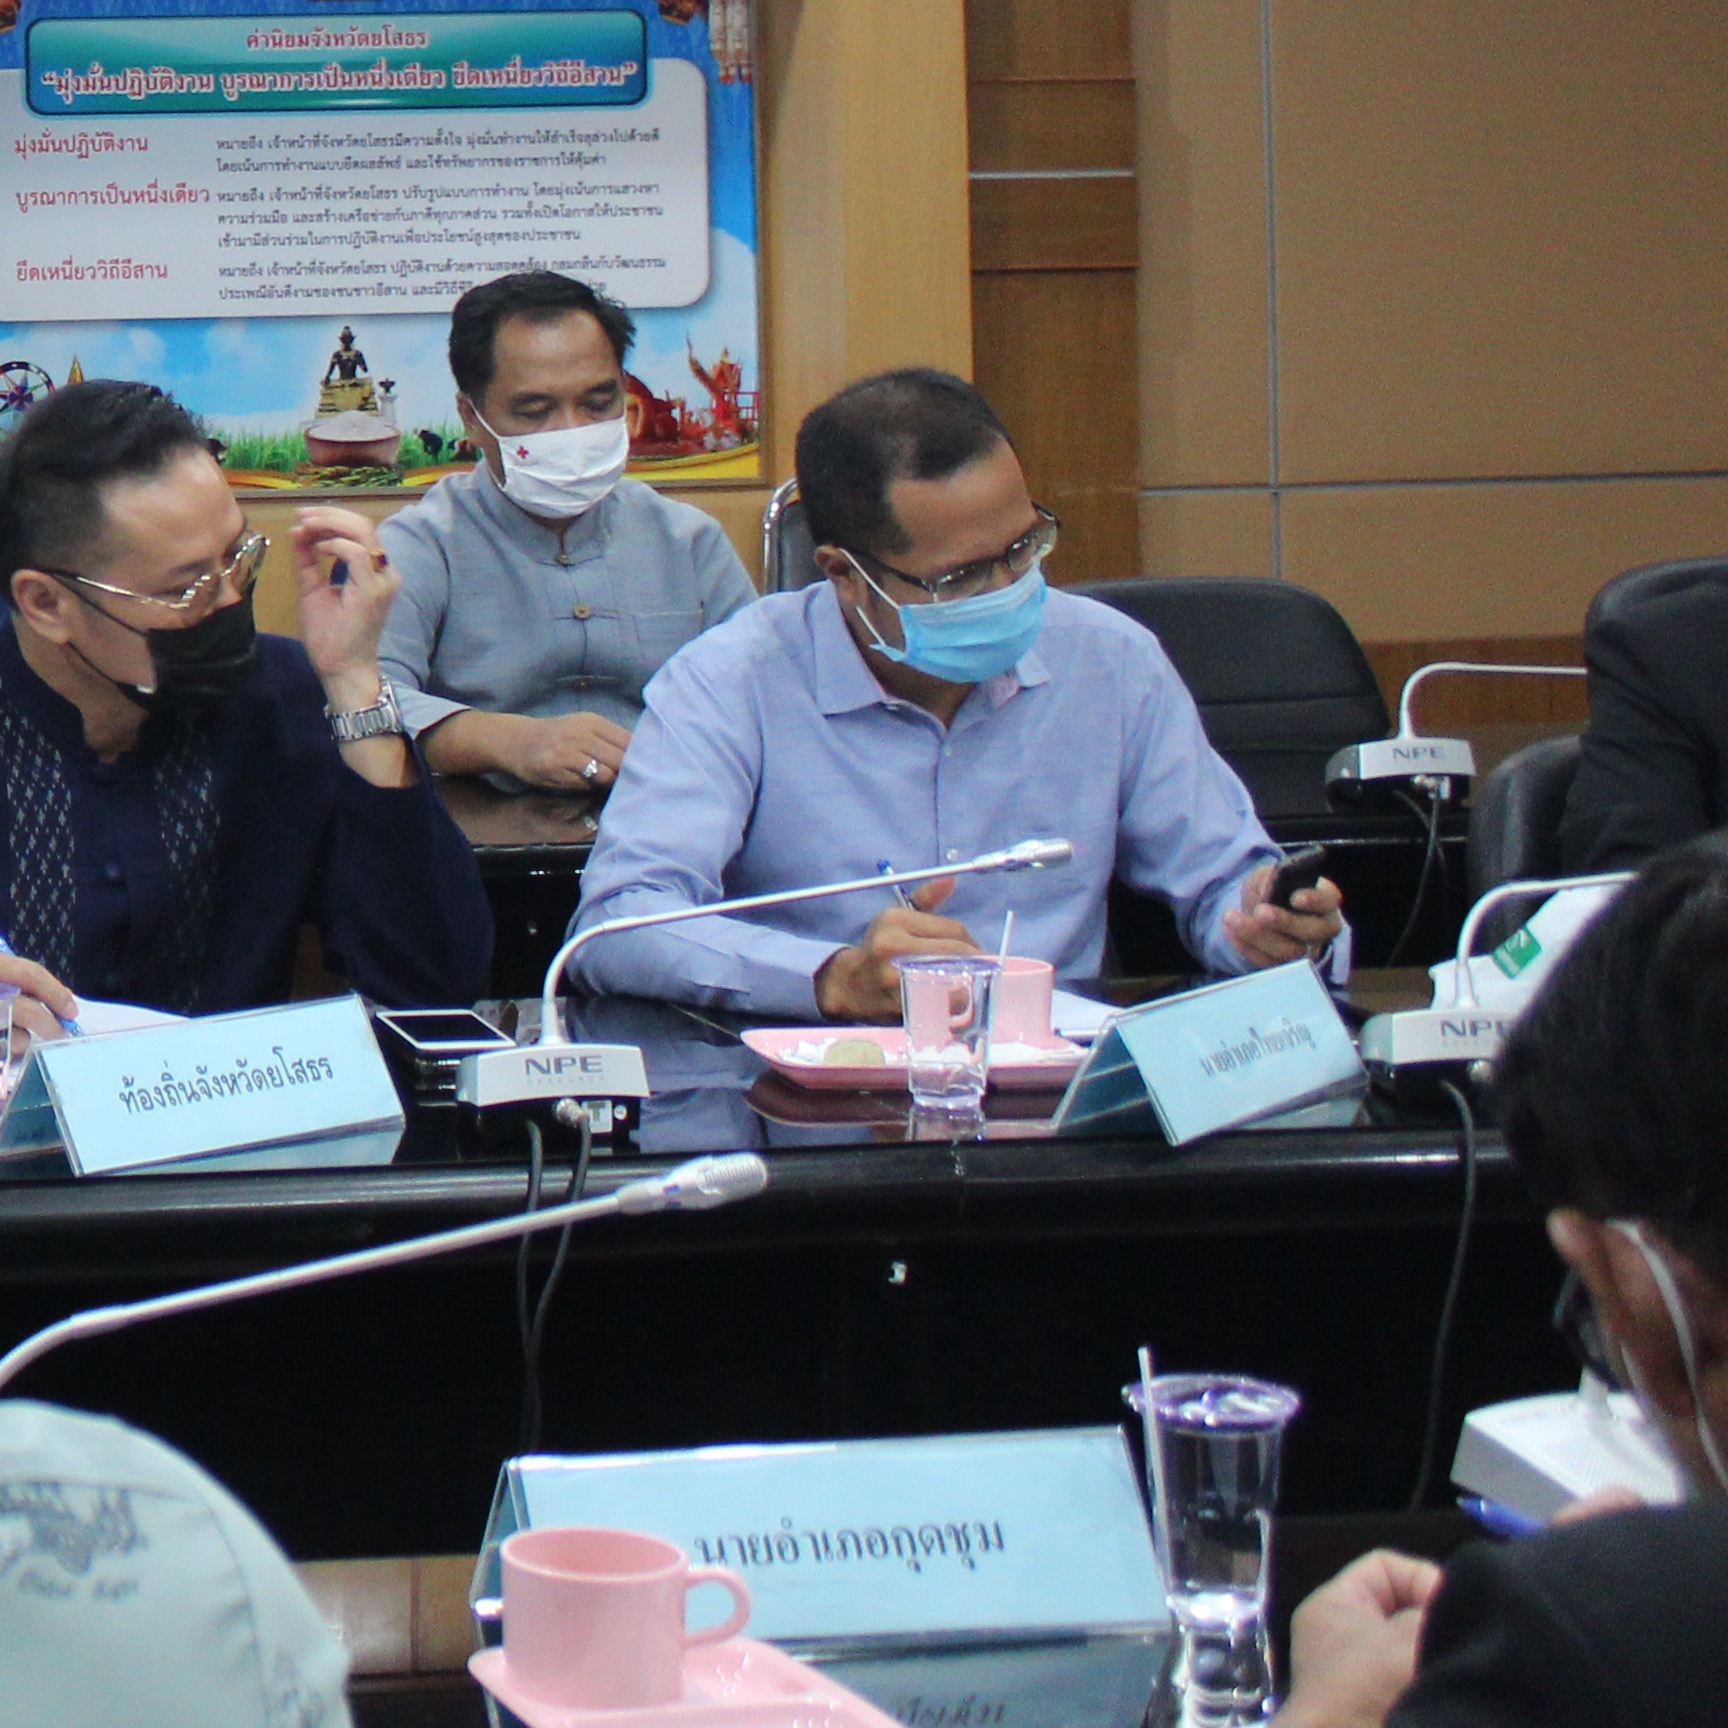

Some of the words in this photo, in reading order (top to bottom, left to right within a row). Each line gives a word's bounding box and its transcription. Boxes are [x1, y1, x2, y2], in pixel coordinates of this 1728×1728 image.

[246, 24, 428, 50] ค่านิยมจังหวัดยโสธร
[14, 128, 148, 160] มุ่งมั่นปฏิบัติงาน
[15, 178, 211, 213] บูรณาการเป็นหนึ่งเดียว
[118, 1046, 334, 1115] ท้องถิ่นจังหวัดยโสธร
[524, 1054, 605, 1076] NPE
[693, 1515, 1004, 1574] นายอำเภอกุดชุม
